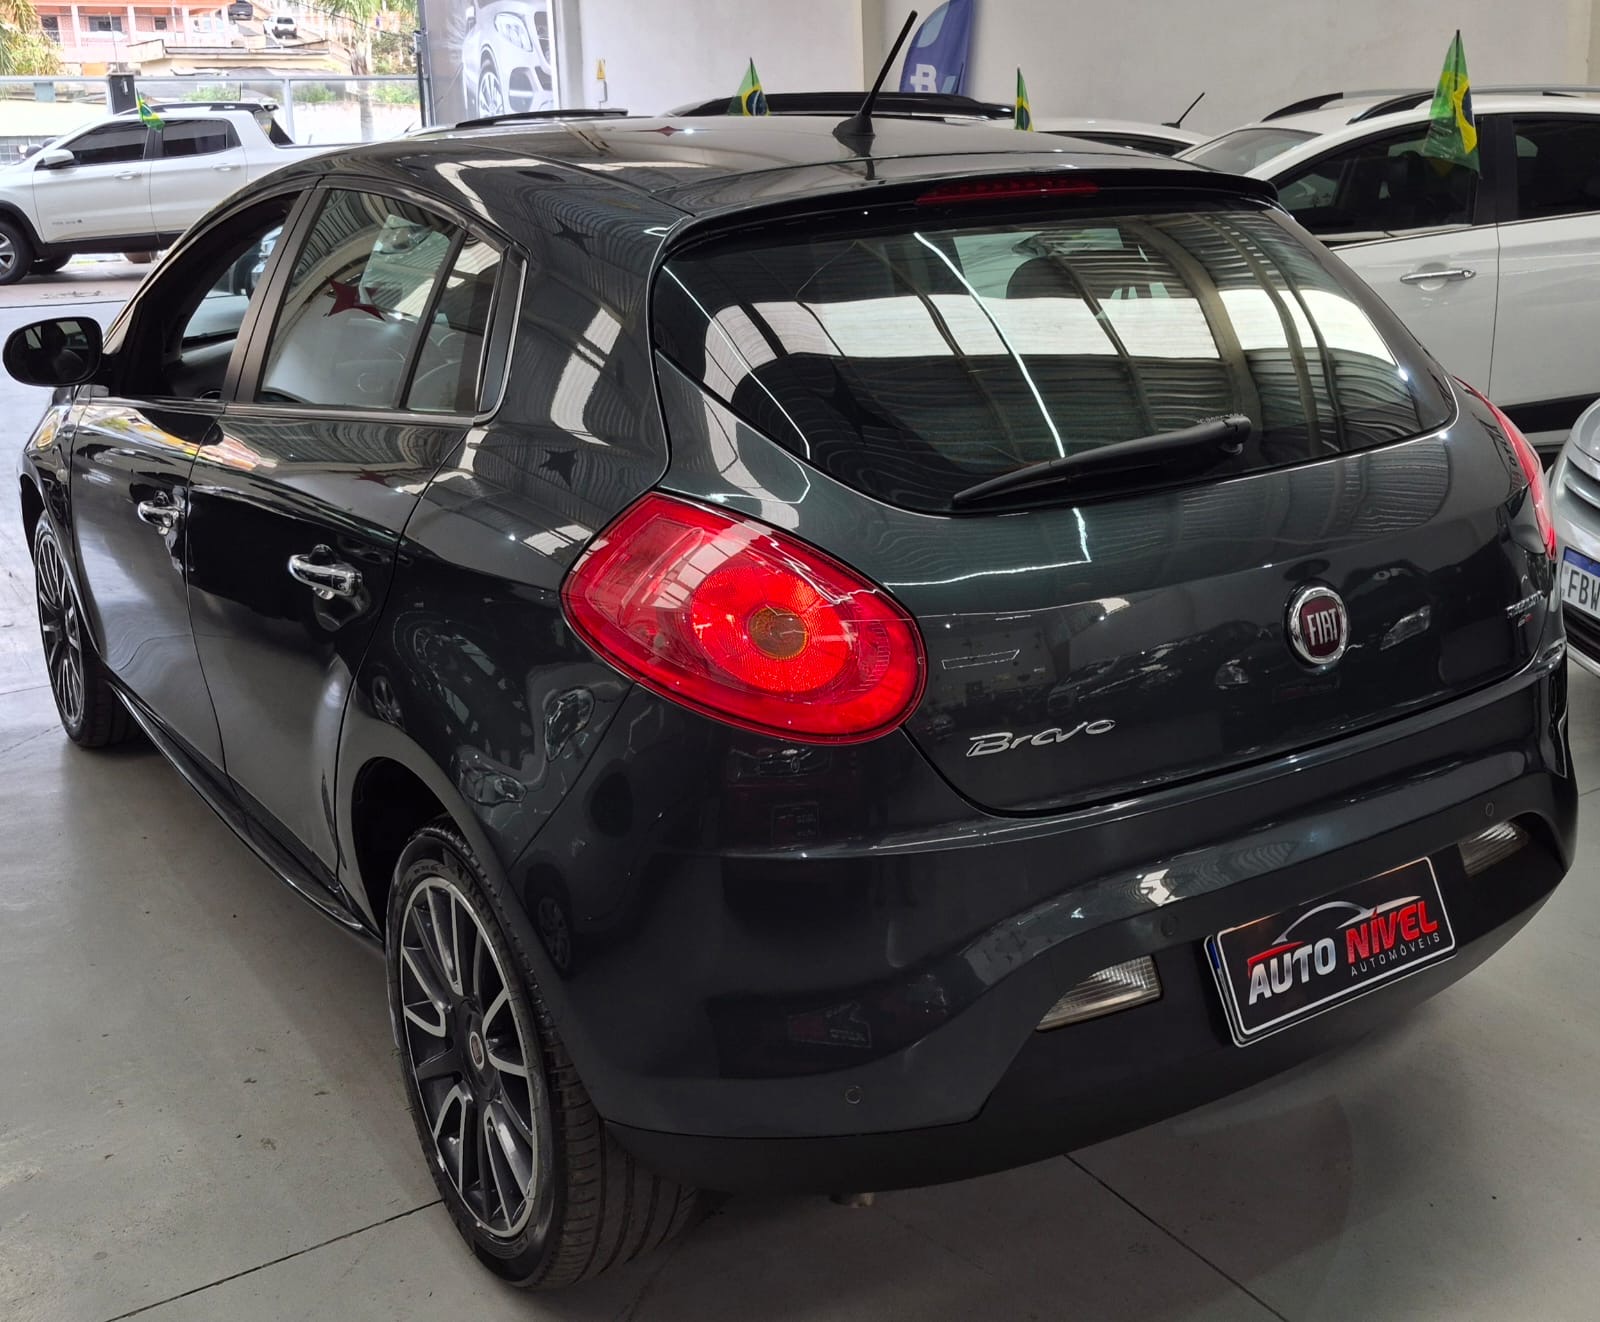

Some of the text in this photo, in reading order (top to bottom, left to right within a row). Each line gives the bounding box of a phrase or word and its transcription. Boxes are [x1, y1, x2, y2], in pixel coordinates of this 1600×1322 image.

[1306, 608, 1338, 647] FIAT
[966, 718, 1116, 758] Bravo
[1248, 901, 1439, 1006] AUTO NÍVEL
[1351, 932, 1441, 977] AUTOMÓVEIS
